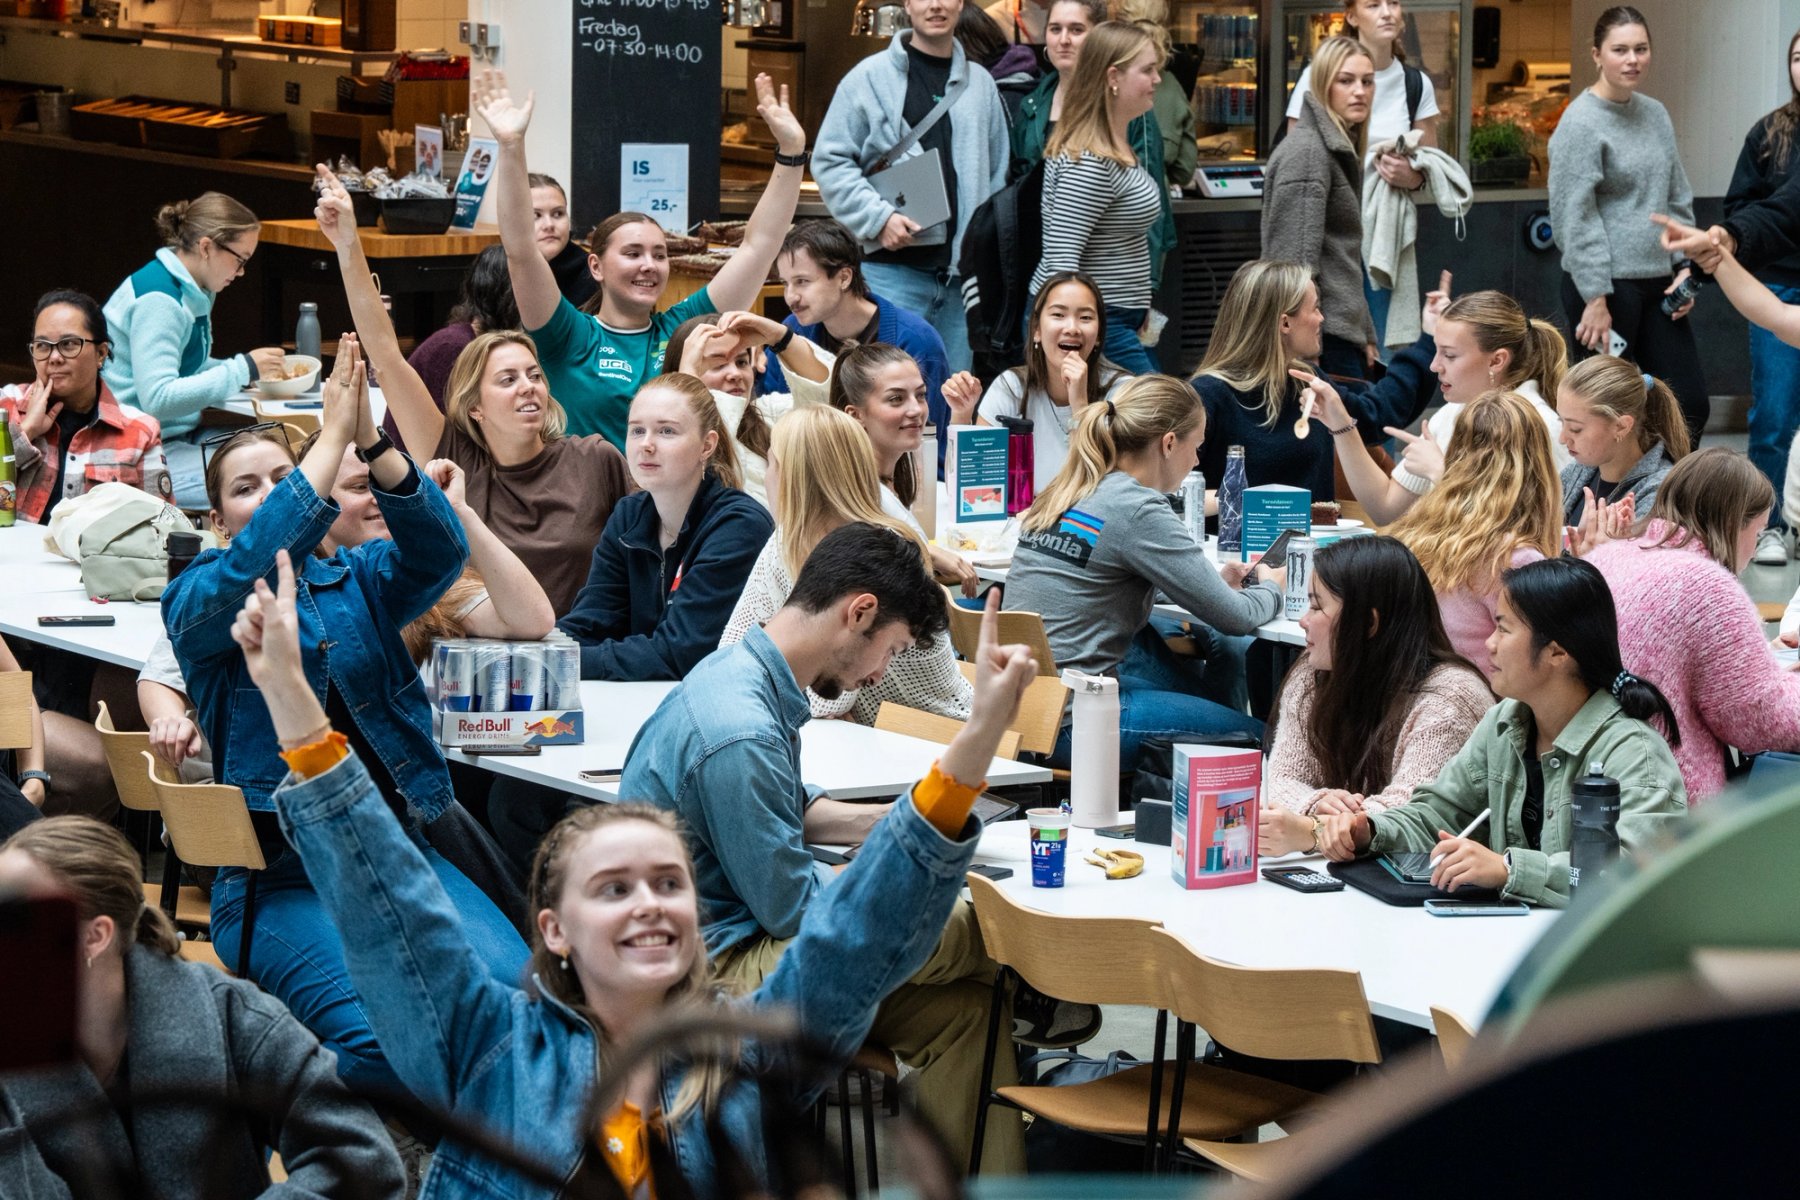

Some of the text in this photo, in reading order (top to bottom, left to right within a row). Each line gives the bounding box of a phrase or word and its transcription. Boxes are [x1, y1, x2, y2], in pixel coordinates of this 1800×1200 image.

[579, 17, 641, 43] Fredag
[633, 160, 650, 175] IS
[458, 717, 511, 732] Red Bull
